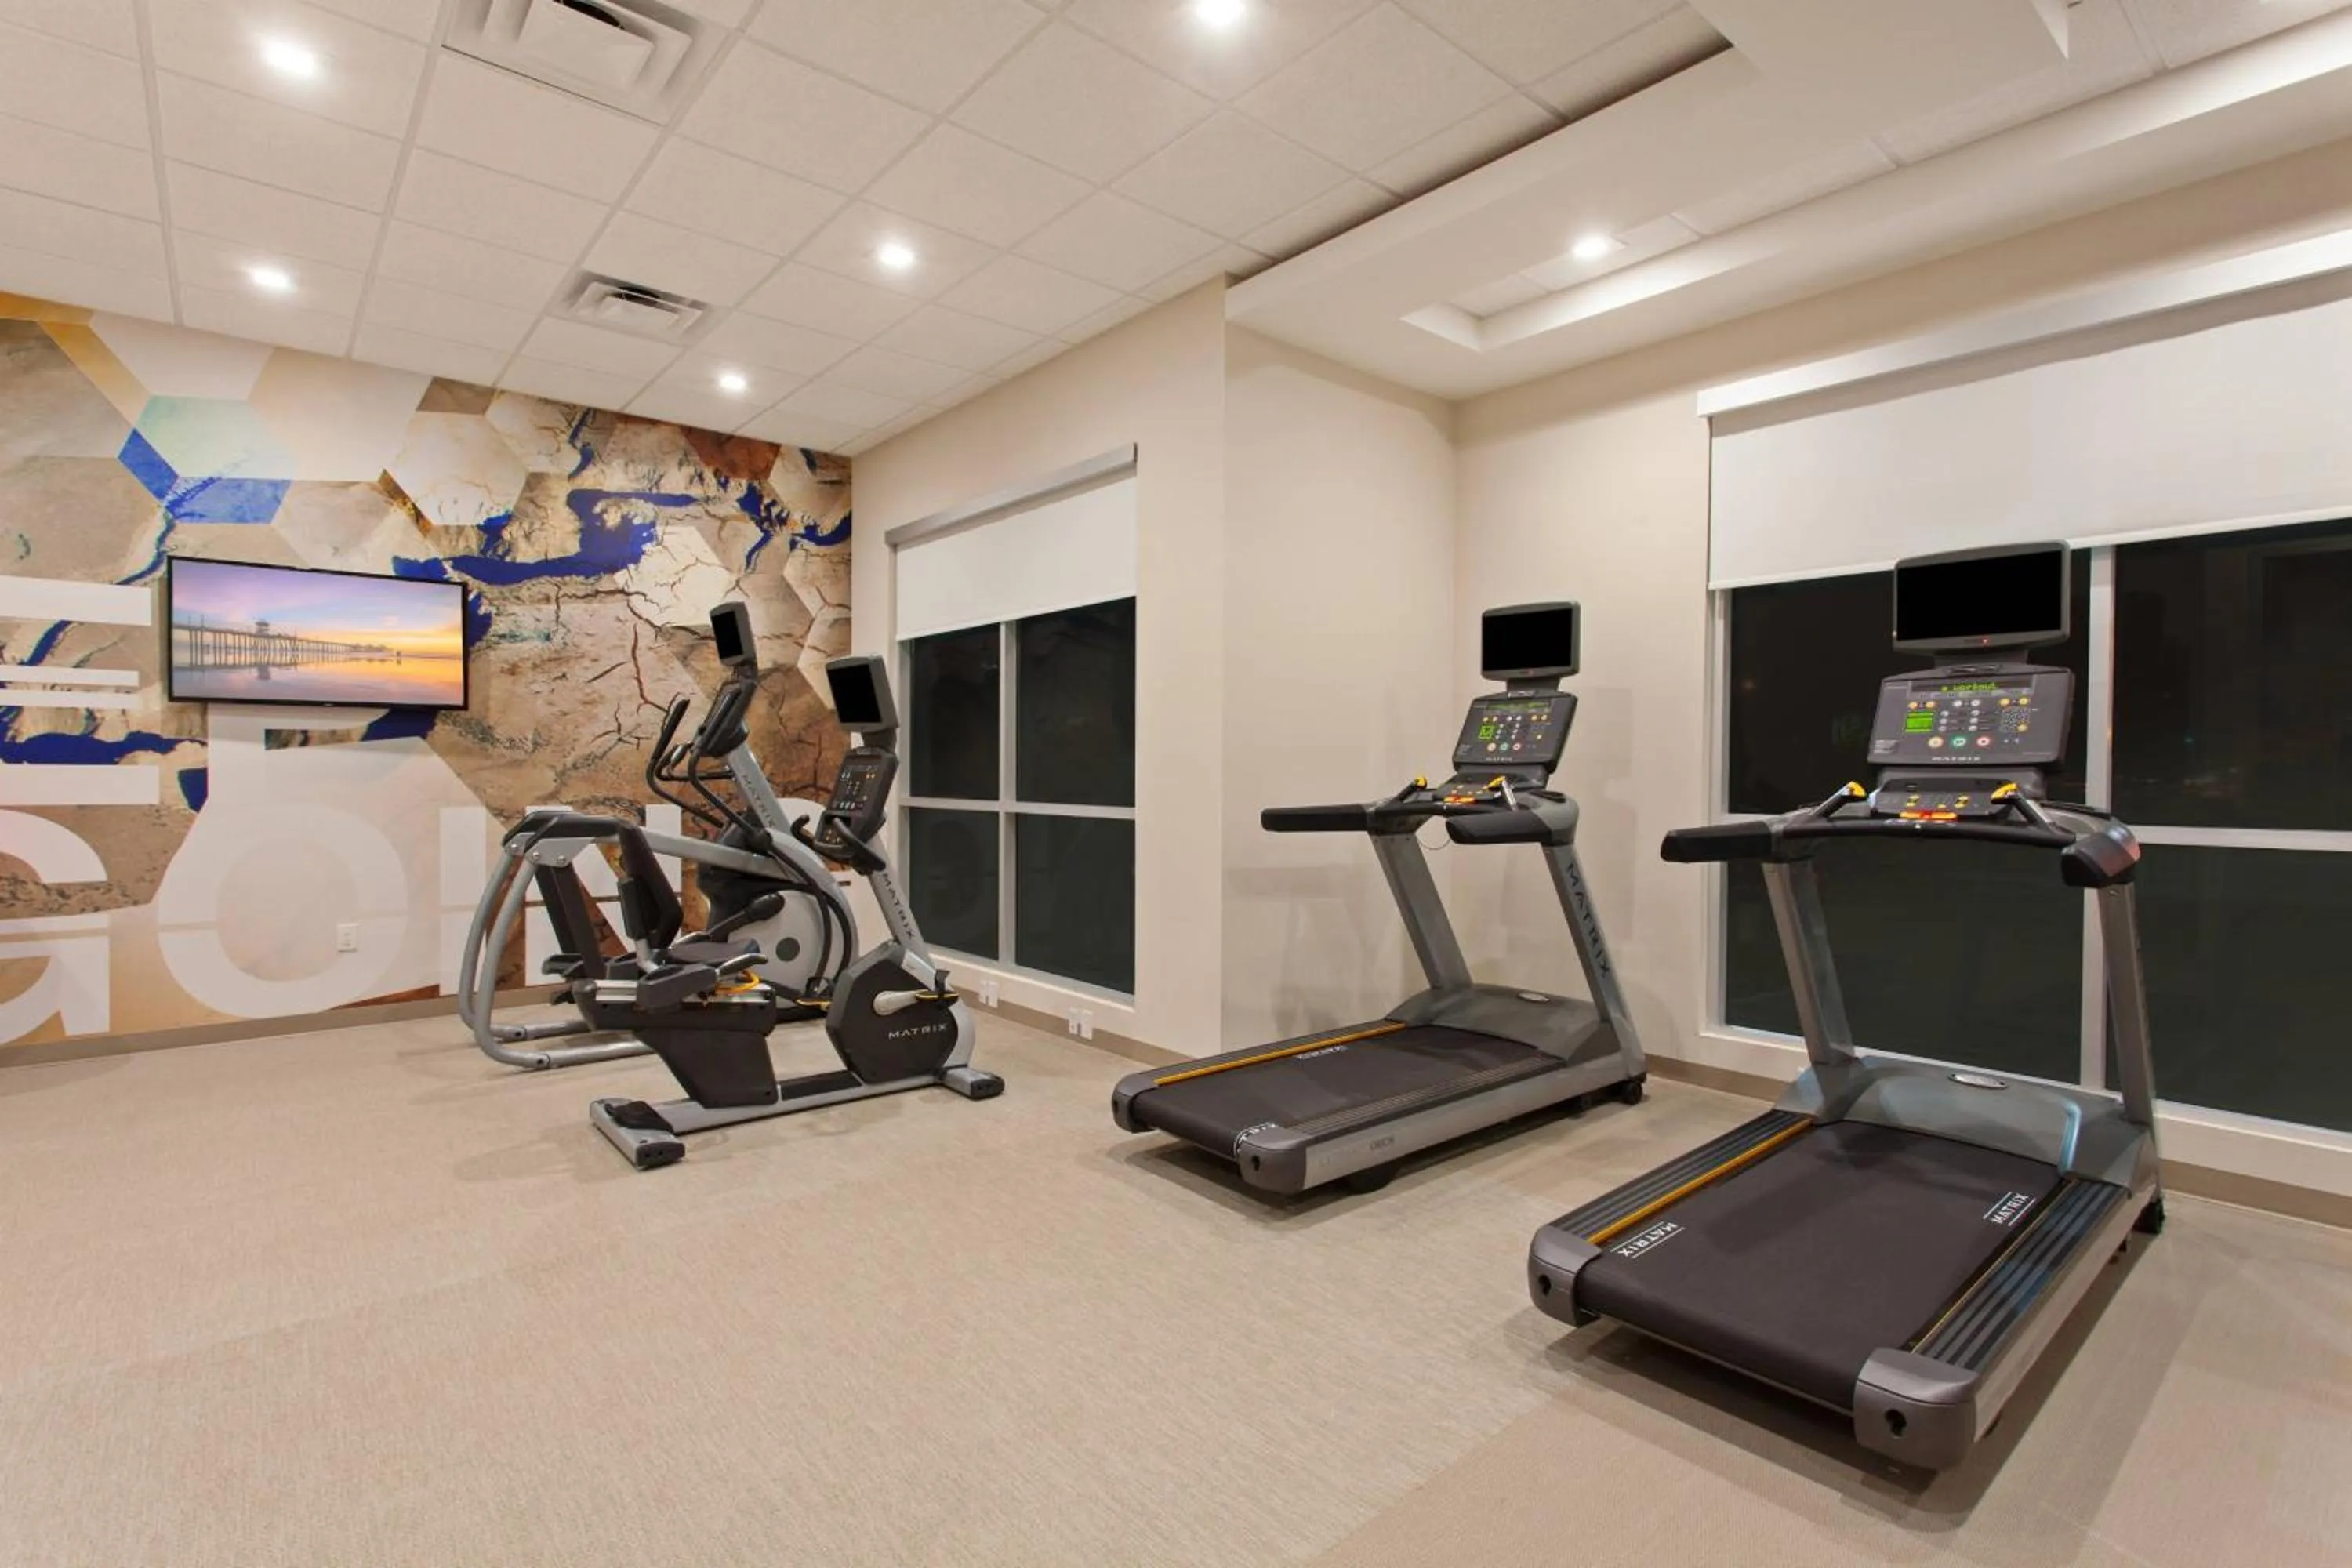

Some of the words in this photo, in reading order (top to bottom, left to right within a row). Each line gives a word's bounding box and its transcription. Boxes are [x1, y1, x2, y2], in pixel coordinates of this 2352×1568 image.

[883, 873, 915, 940] MATRIX
[1566, 863, 1610, 978] MATRIX
[888, 1022, 949, 1040] MATRIX
[1991, 1193, 2028, 1224] MATRIX
[1617, 1222, 1679, 1257] MATRIX
